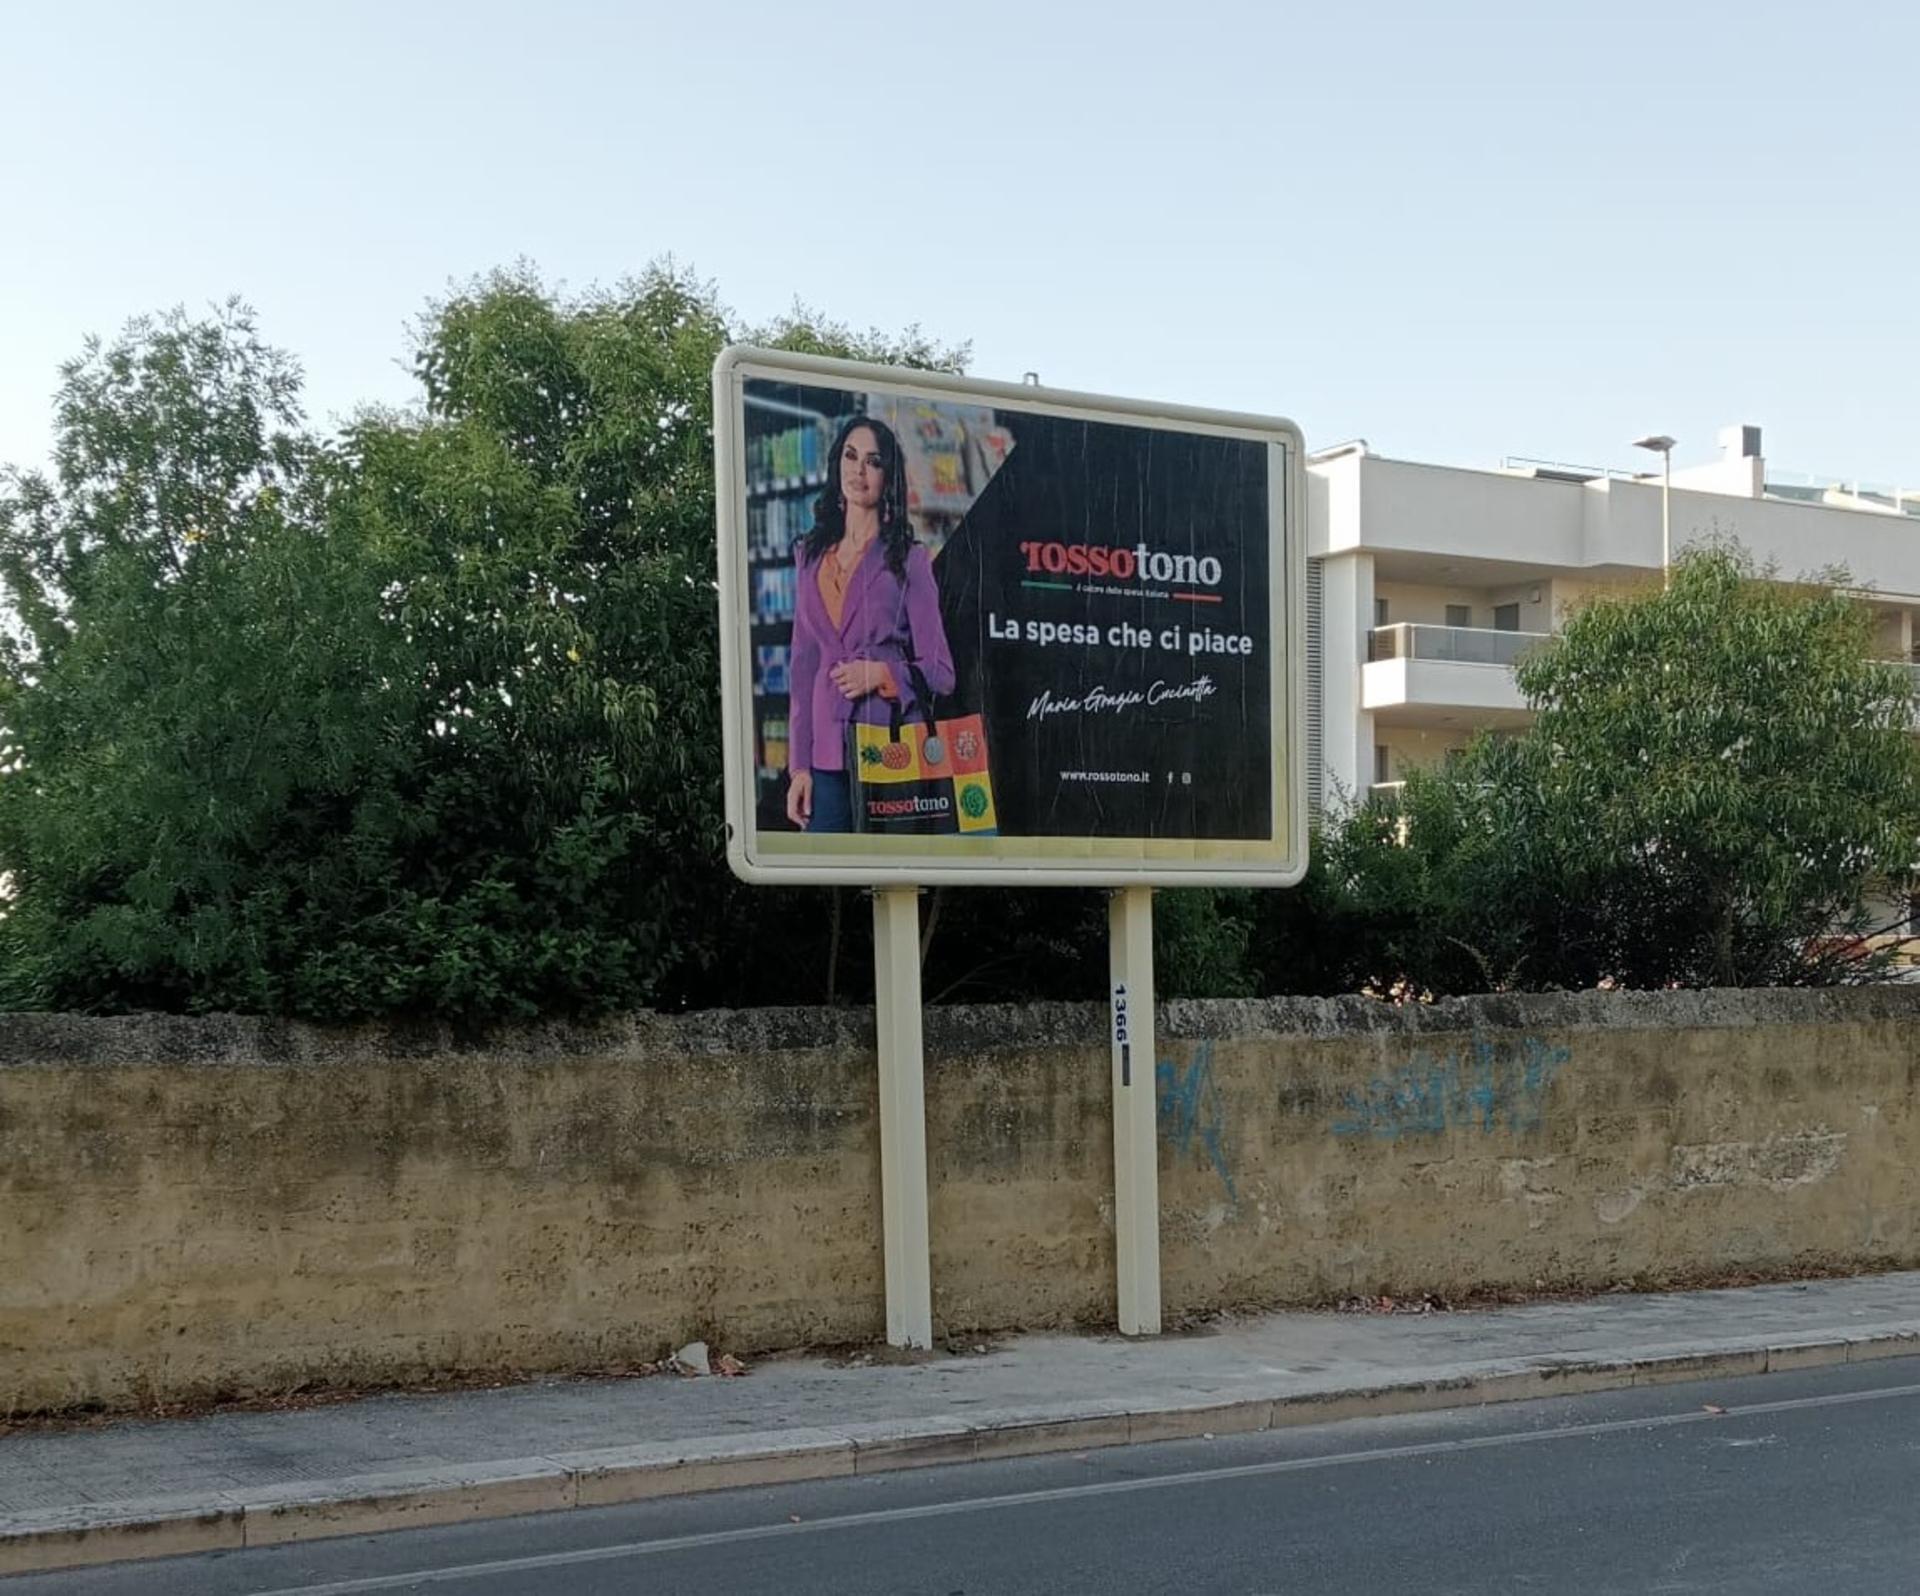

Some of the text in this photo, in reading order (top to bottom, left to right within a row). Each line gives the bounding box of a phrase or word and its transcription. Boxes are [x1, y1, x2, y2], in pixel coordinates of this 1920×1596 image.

[1020, 541, 1222, 585] rossotono
[989, 612, 1253, 656] La spesa che ci piace
[1026, 690, 1081, 722] Maria
[1060, 771, 1150, 783] www.rossotono.it
[867, 795, 949, 815] rossotono
[1115, 984, 1127, 1042] 1366
